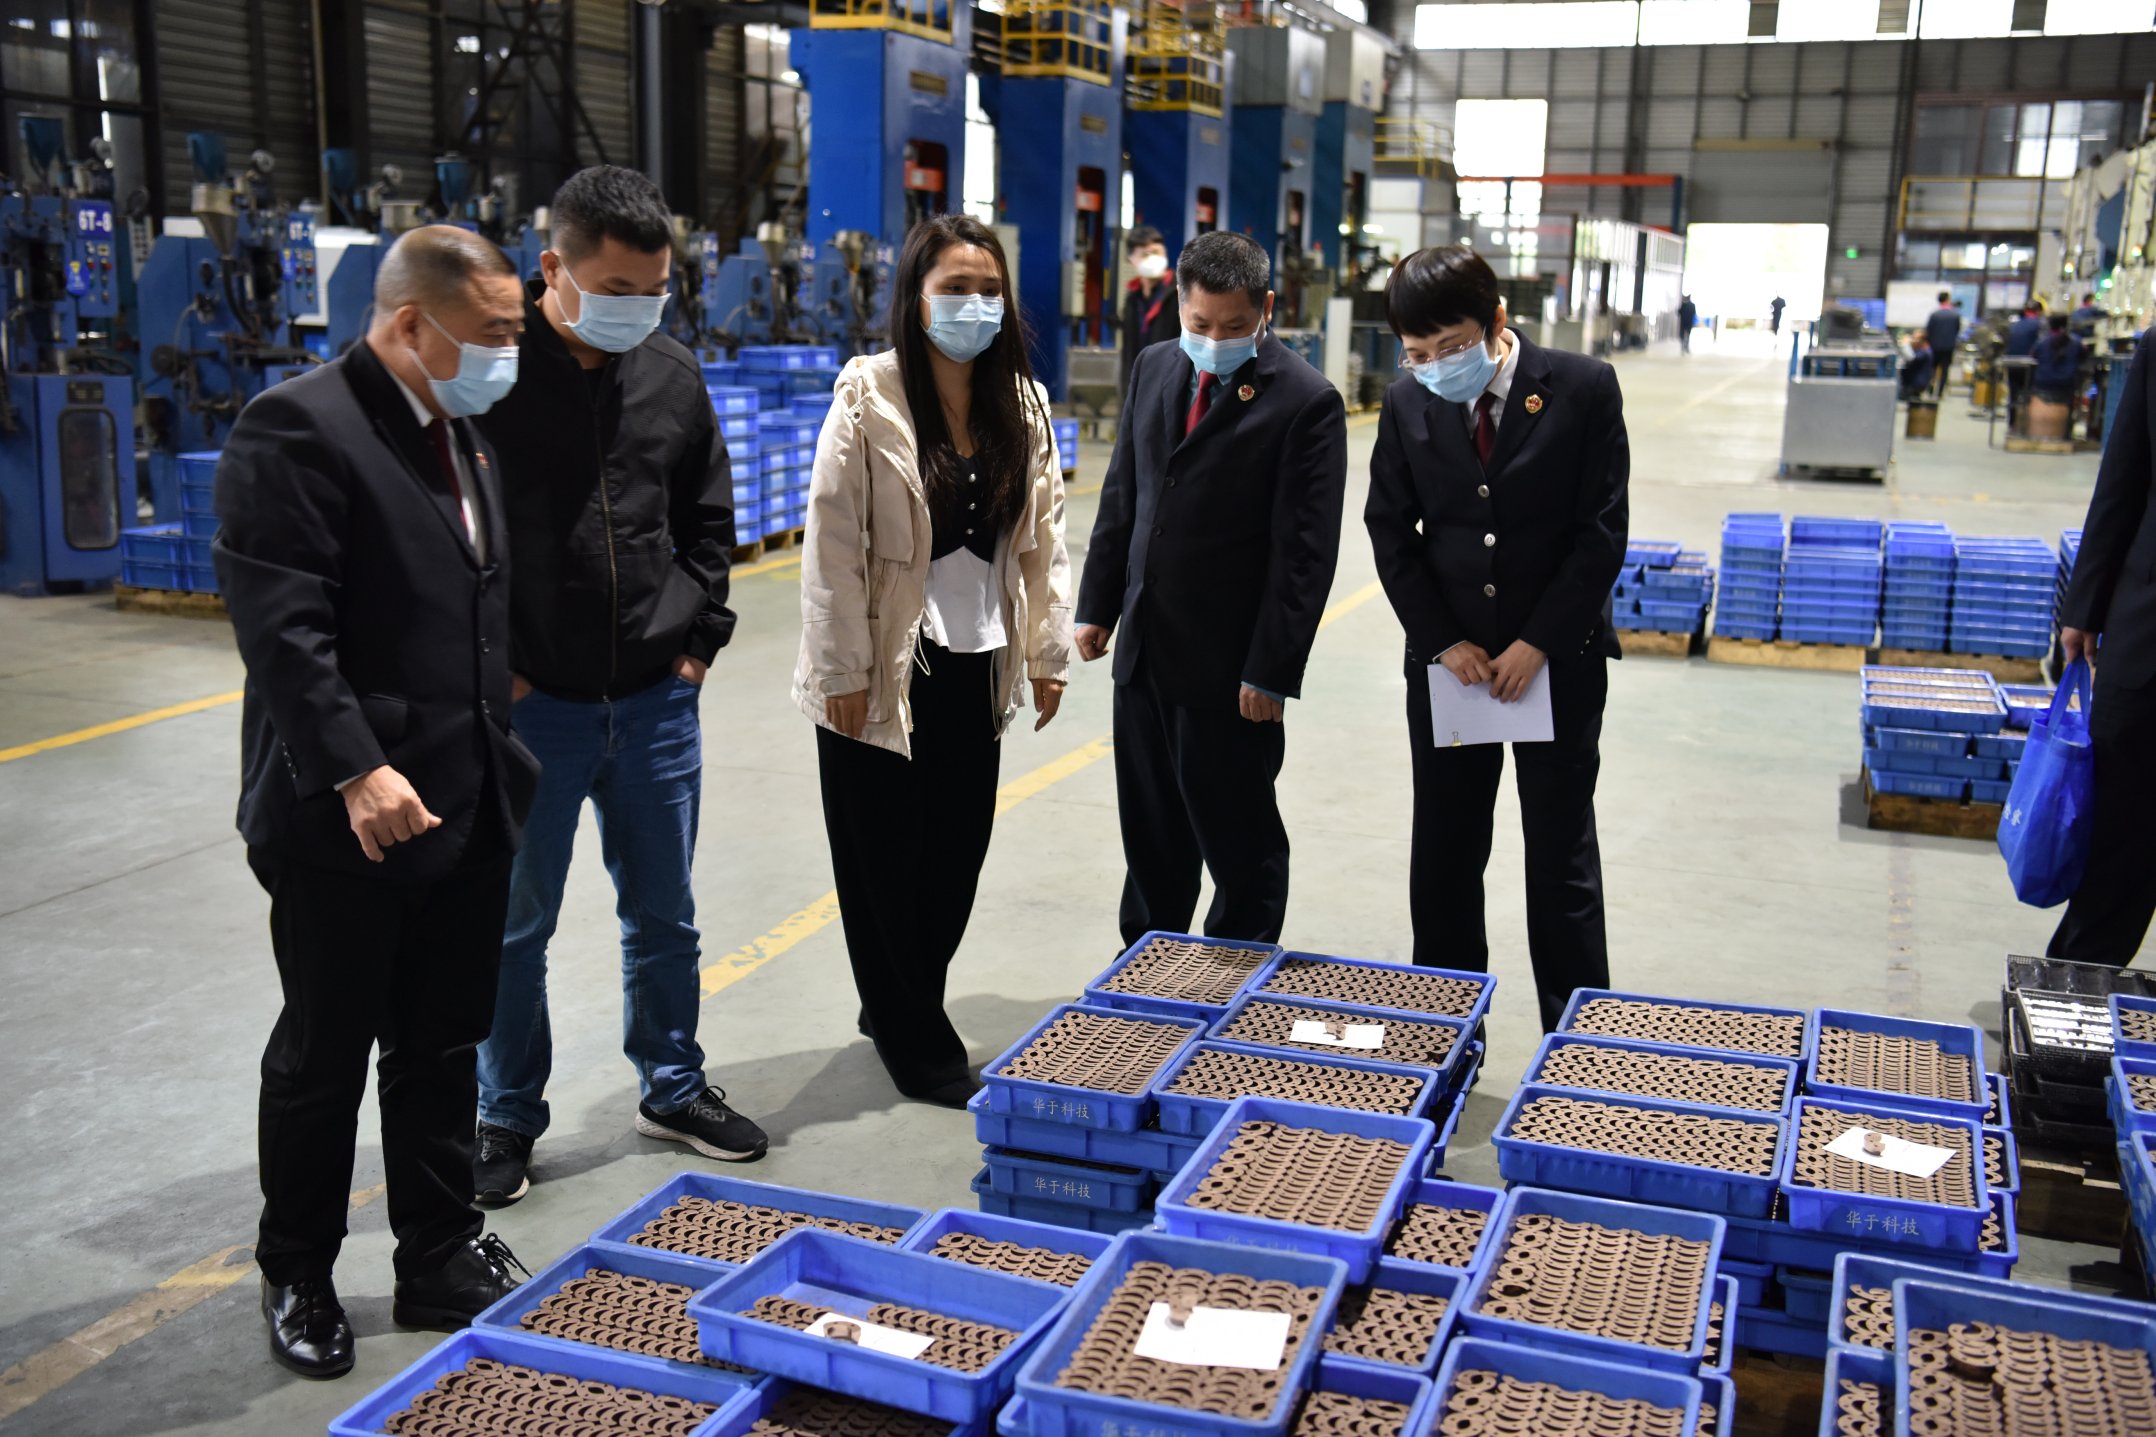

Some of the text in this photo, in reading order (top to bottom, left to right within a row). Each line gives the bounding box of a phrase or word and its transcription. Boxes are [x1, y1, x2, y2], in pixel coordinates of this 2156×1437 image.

[1033, 1097, 1090, 1120] 华于科技
[1034, 1176, 1091, 1199] 华于科技
[1846, 1210, 1919, 1236] 华于科技
